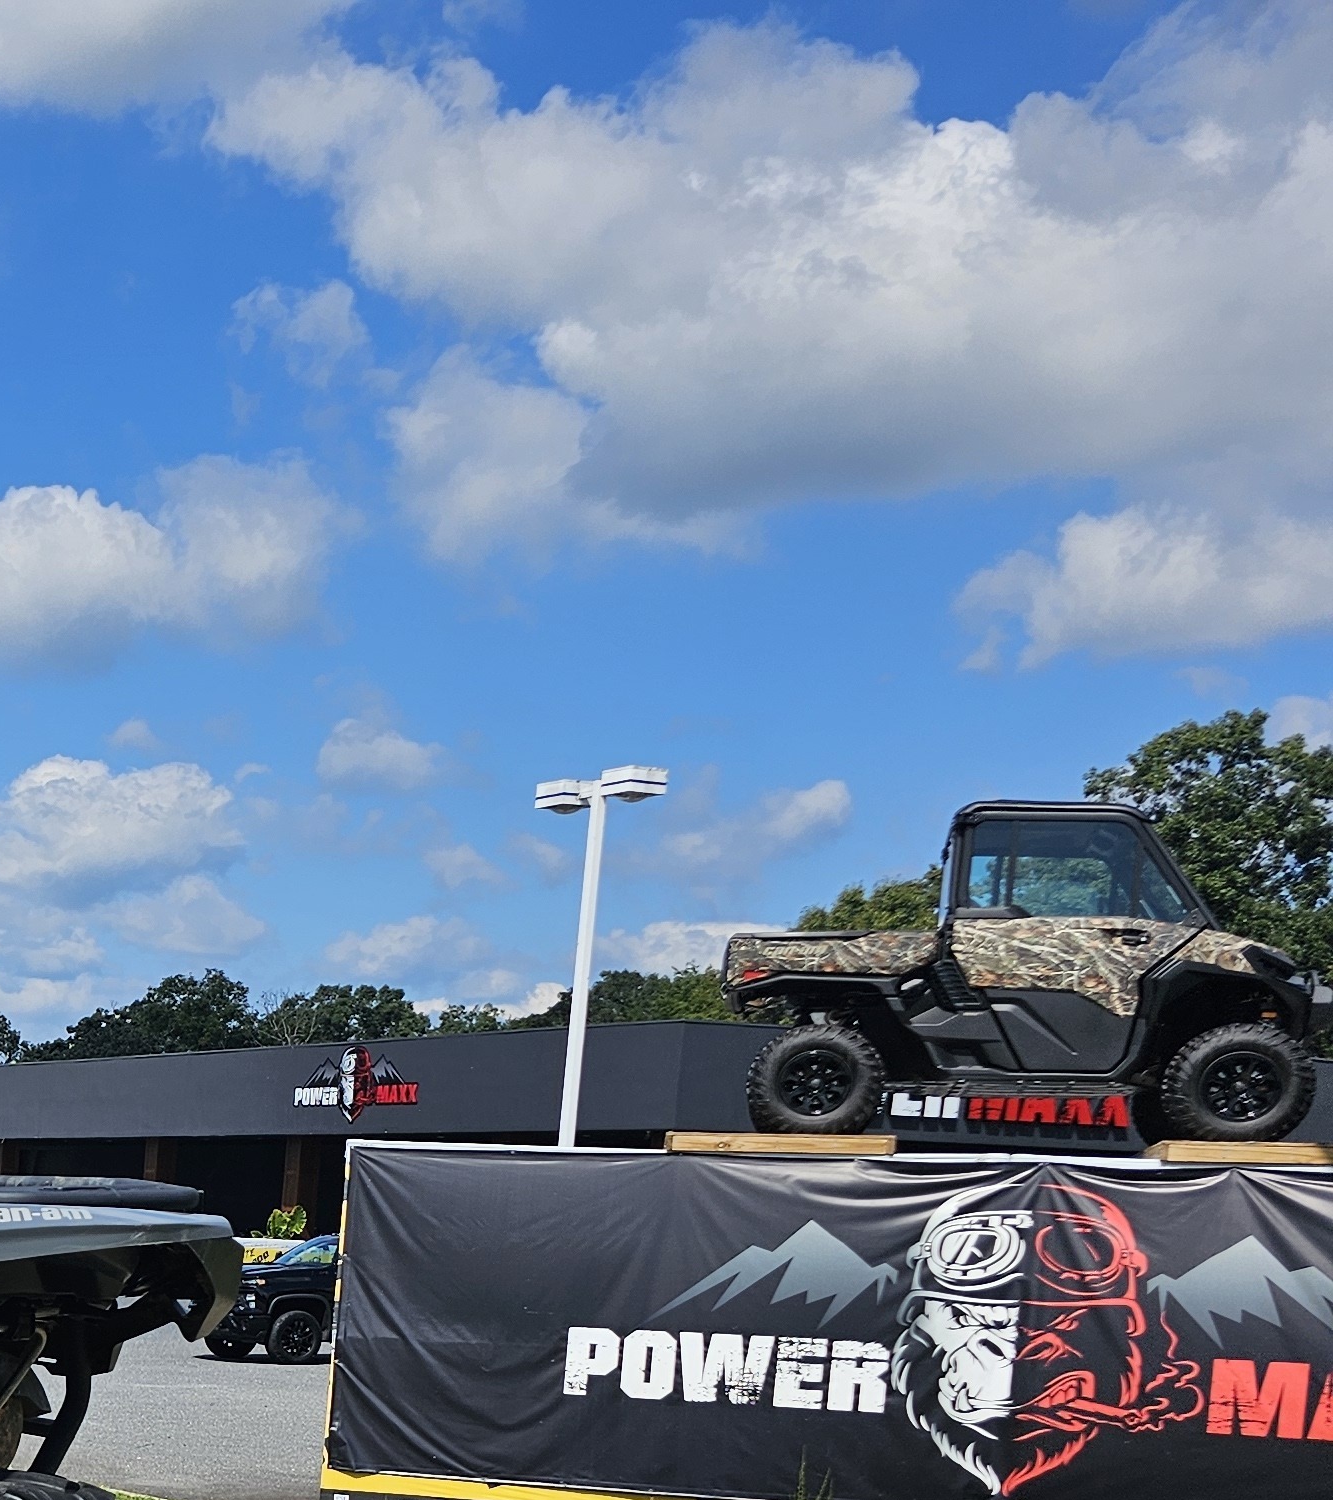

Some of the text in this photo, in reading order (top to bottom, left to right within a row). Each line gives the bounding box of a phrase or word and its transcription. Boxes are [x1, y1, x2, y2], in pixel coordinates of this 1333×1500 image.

[294, 1083, 418, 1107] POWER MAXX
[563, 1326, 890, 1413] POWER
